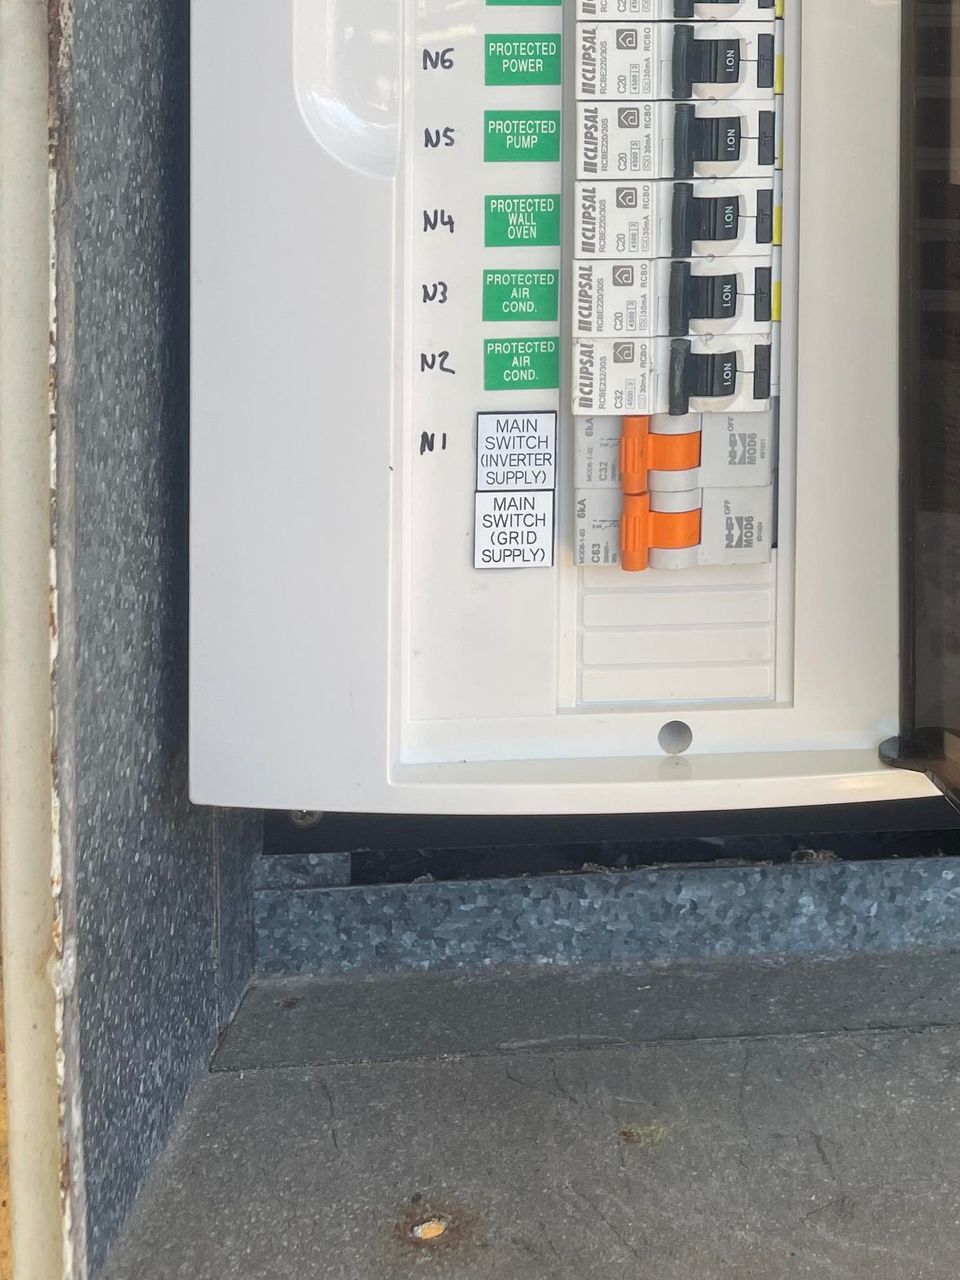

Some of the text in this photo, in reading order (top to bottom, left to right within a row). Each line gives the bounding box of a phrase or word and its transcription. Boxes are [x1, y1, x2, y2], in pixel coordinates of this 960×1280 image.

[422, 47, 455, 70] N6
[488, 42, 557, 57] PROTECTED
[582, 27, 597, 81] CLIPSAL
[502, 58, 544, 73] POWER
[617, 75, 627, 94] C20
[488, 119, 557, 134] PROTECTED
[583, 107, 598, 160] CLIPSAL
[424, 126, 455, 148] N5
[506, 134, 538, 149] PUMP
[618, 152, 627, 171] C20
[490, 199, 555, 213] PROTECTED
[582, 187, 597, 240] CLIPSAL
[423, 209, 455, 233] N4
[508, 213, 536, 226] WALL
[507, 227, 538, 240] OVEN
[616, 233, 625, 252] C20
[486, 273, 555, 286] PROTECTED
[422, 282, 448, 304] N3
[510, 287, 530, 300] AIR
[578, 265, 593, 319] CLIPSAL
[502, 301, 538, 314] COND.
[613, 312, 623, 331] C20
[486, 341, 555, 355] PROTECTED
[420, 353, 455, 374] N2
[511, 356, 531, 368] AIR
[579, 343, 594, 395] CLIPSAL
[503, 370, 539, 382] COND.
[614, 389, 624, 409] C32
[495, 418, 538, 433] MAIN
[727, 416, 735, 432] OFF
[419, 432, 448, 454] N1
[484, 434, 550, 450] SWITCH
[746, 432, 757, 465] MOD6
[479, 451, 553, 469] (INVERTER
[485, 470, 547, 486] SUPPLY)
[598, 461, 608, 481] C32
[492, 496, 536, 511] MAIN
[576, 498, 586, 519] 6kA
[482, 512, 547, 528] SWITCH
[489, 529, 538, 546] (GRID
[743, 515, 754, 548] MOD6
[481, 548, 546, 564] SUPPLY)
[591, 543, 601, 564] C63
